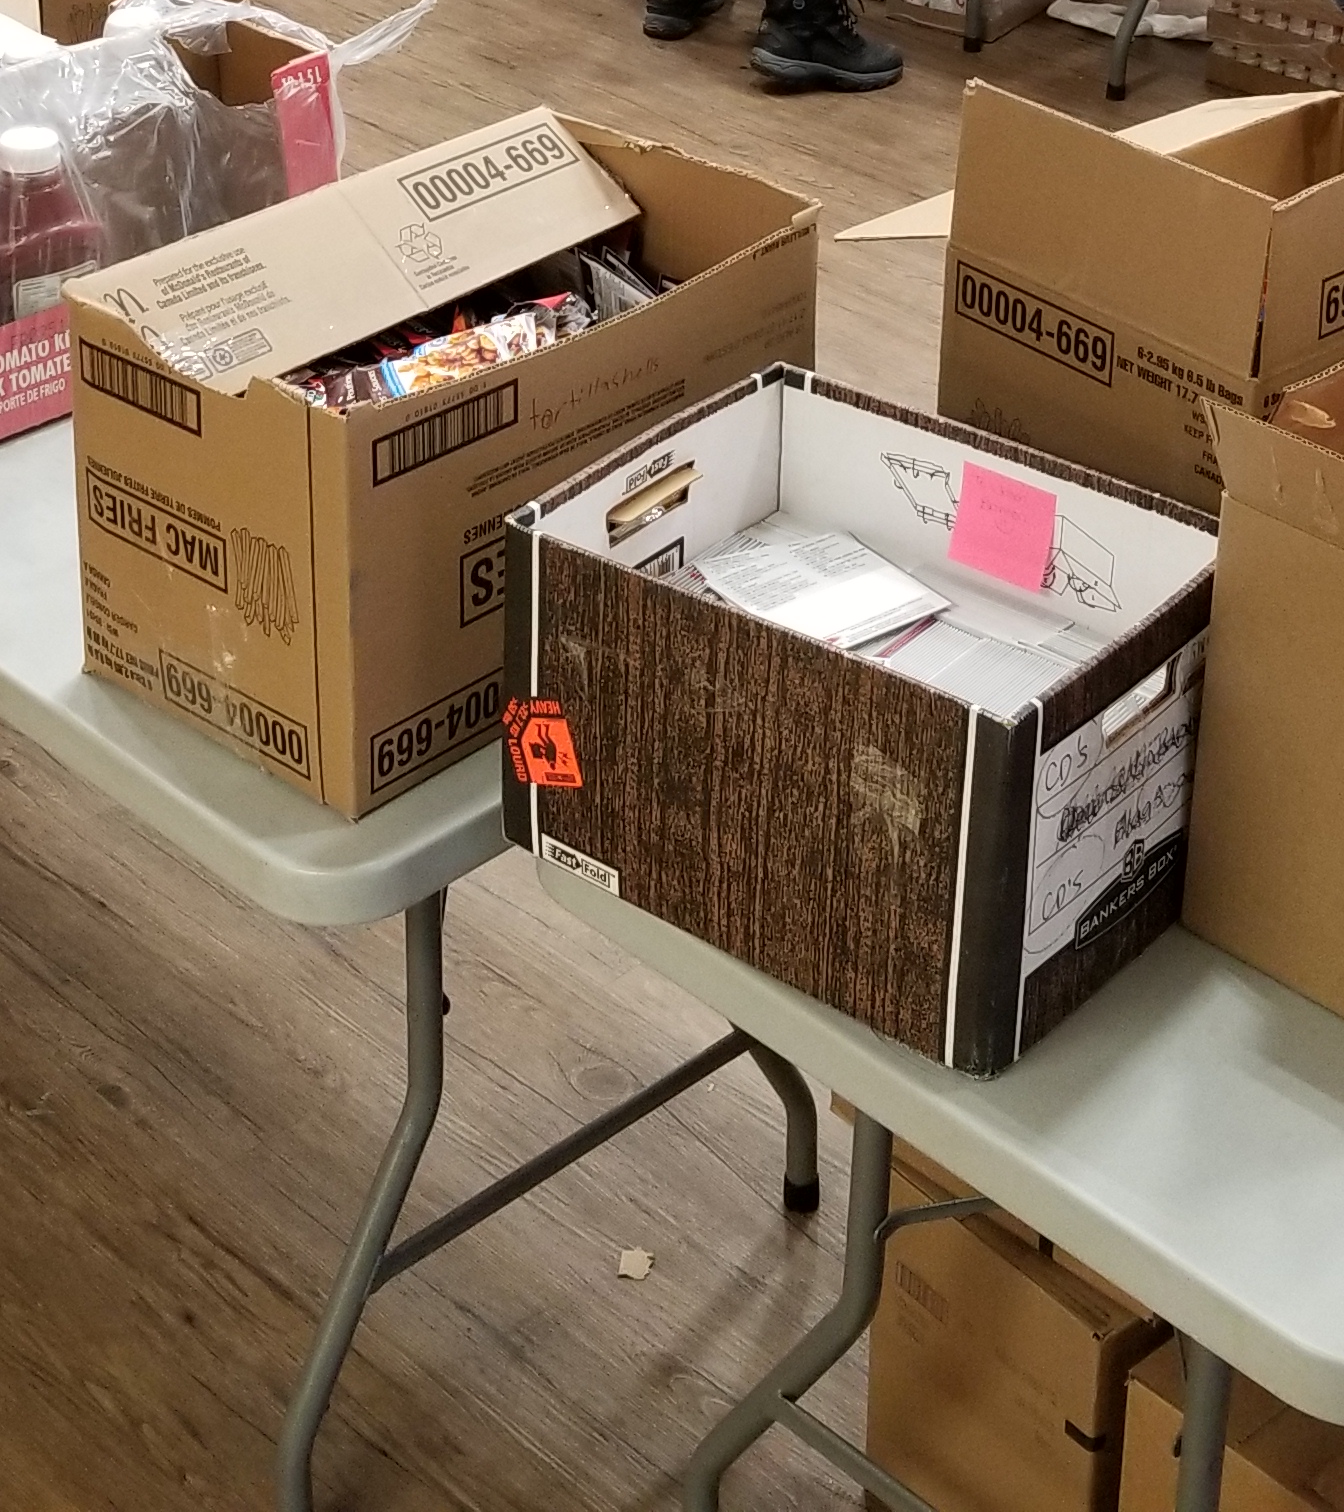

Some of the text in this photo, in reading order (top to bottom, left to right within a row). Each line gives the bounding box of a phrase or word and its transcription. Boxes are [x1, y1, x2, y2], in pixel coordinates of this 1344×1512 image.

[412, 133, 566, 211] 00004-669
[182, 264, 194, 278] for
[961, 273, 1107, 373] 00004-669
[25, 392, 39, 404] DE
[39, 377, 66, 400] FRIGO
[1116, 355, 1199, 405] NET WEIGHT 17.7
[1137, 346, 1244, 407] 6-2.95 kg 6.5 lb Bags
[1183, 423, 1204, 444] KEEP
[627, 453, 670, 489] Fast Fold
[92, 483, 219, 578] MAC FRIES
[529, 700, 562, 715] HEAVY
[508, 738, 528, 783] LOURD
[554, 848, 607, 883] Fast Fold
[1080, 851, 1174, 940] BANKERS BOX
